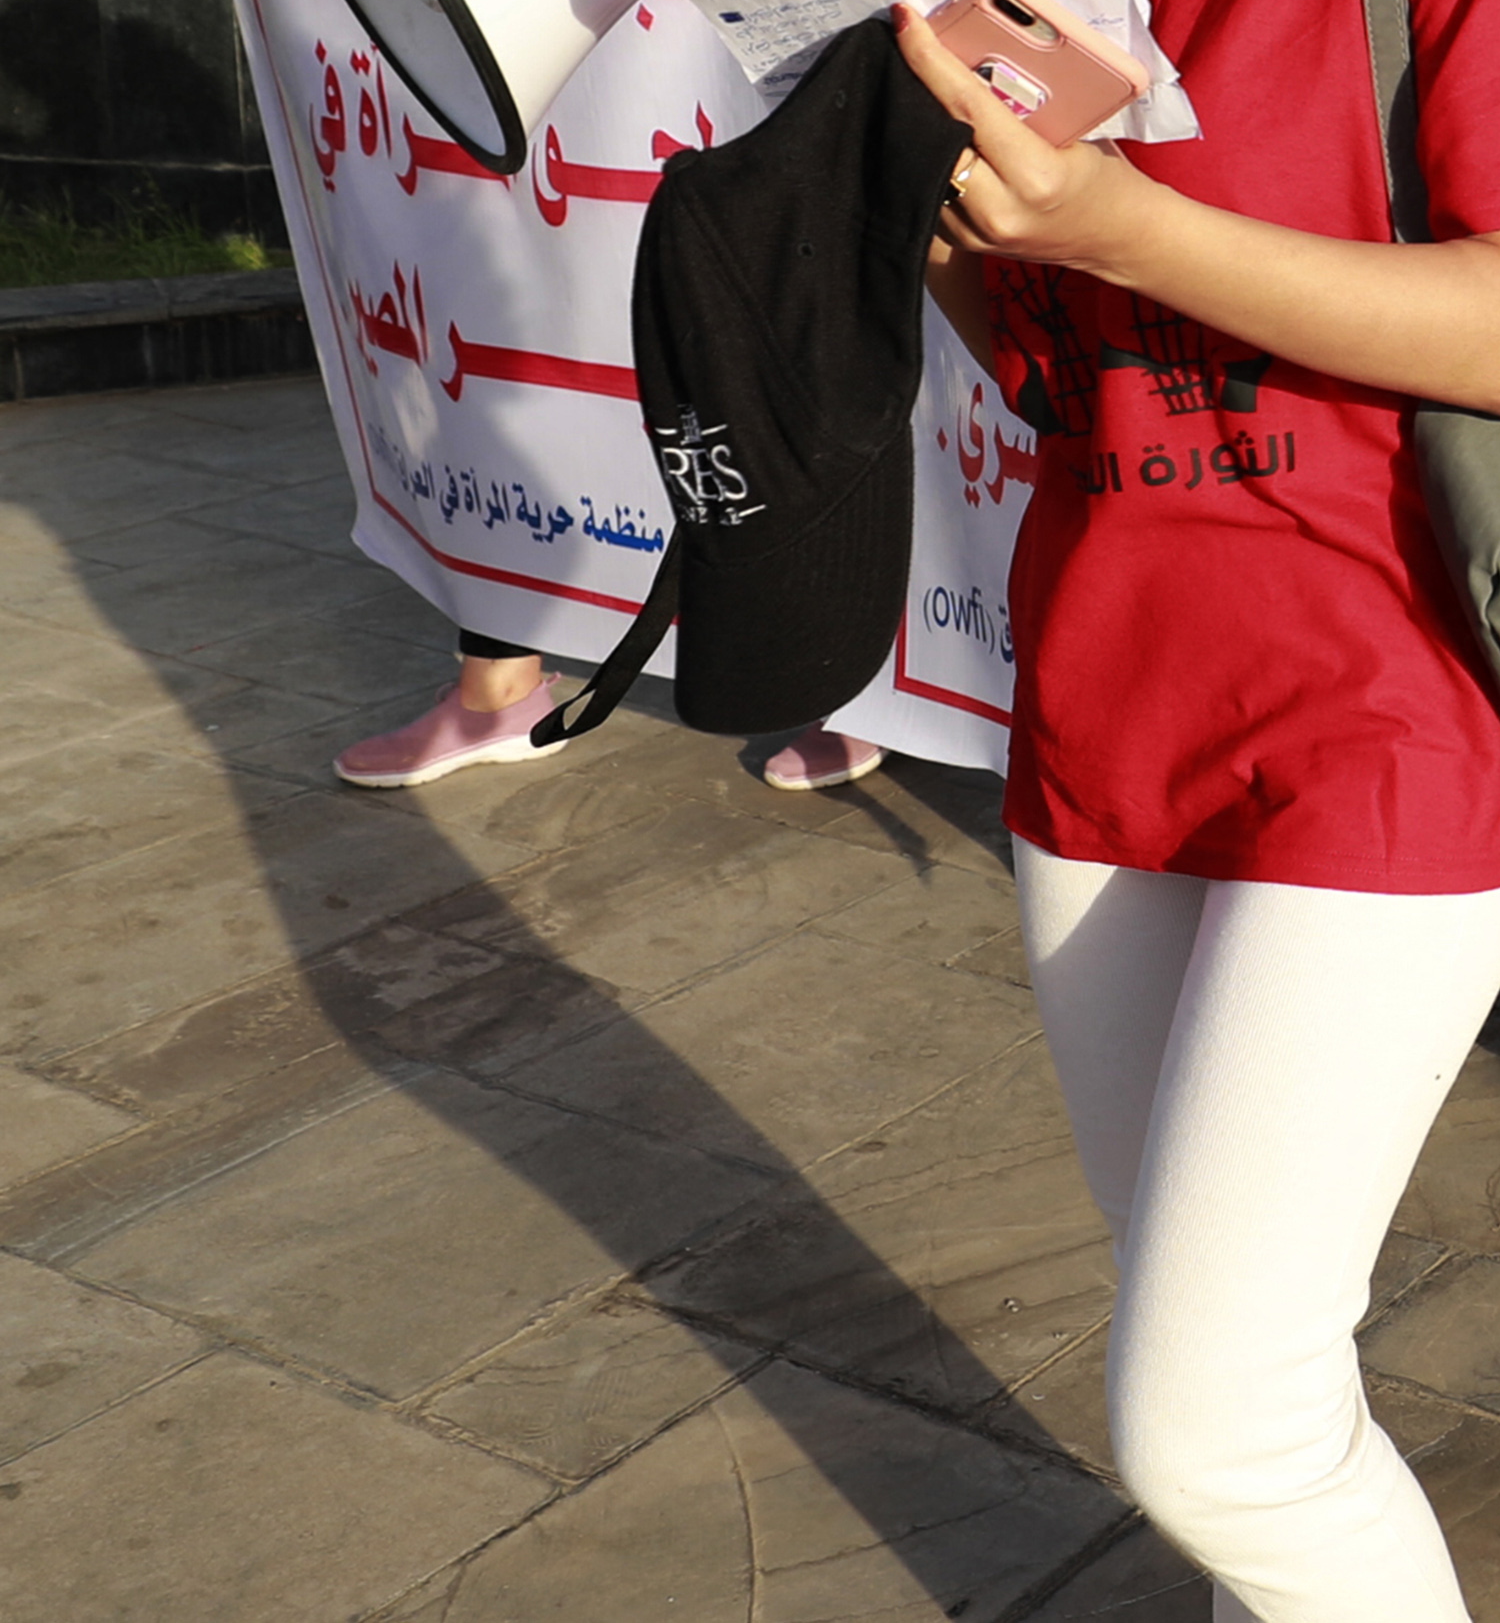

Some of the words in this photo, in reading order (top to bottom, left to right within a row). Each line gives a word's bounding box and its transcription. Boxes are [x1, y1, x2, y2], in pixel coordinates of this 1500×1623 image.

[308, 37, 347, 195] في
[1139, 429, 1297, 492] الثورة
[439, 464, 460, 525] في
[461, 466, 511, 530] المرأة
[511, 482, 575, 544] حرية
[580, 494, 666, 554] منظمة
